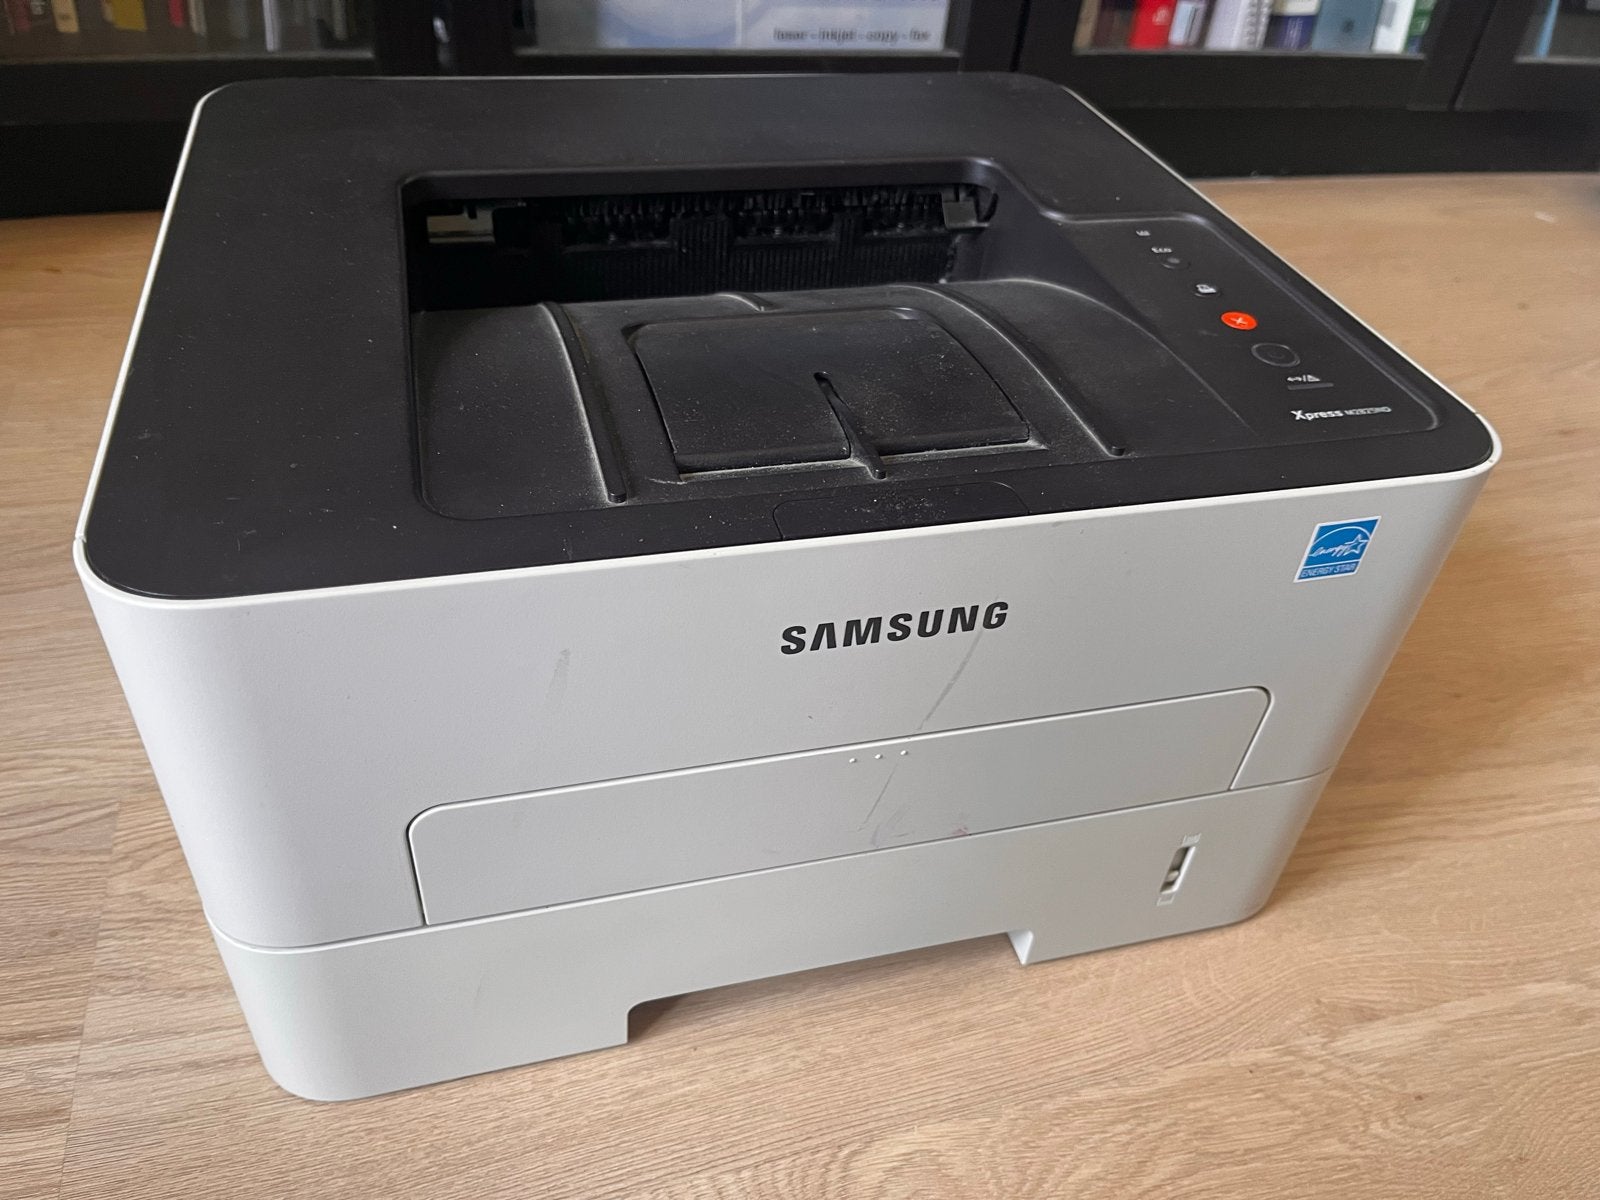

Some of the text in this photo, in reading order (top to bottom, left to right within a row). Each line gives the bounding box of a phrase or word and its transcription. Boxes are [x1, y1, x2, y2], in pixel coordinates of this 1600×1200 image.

[865, 30, 898, 45] copy
[1291, 409, 1344, 420] Xpress
[1301, 563, 1356, 578] ENERGY STAR
[780, 601, 1009, 655] SAMSUNG
